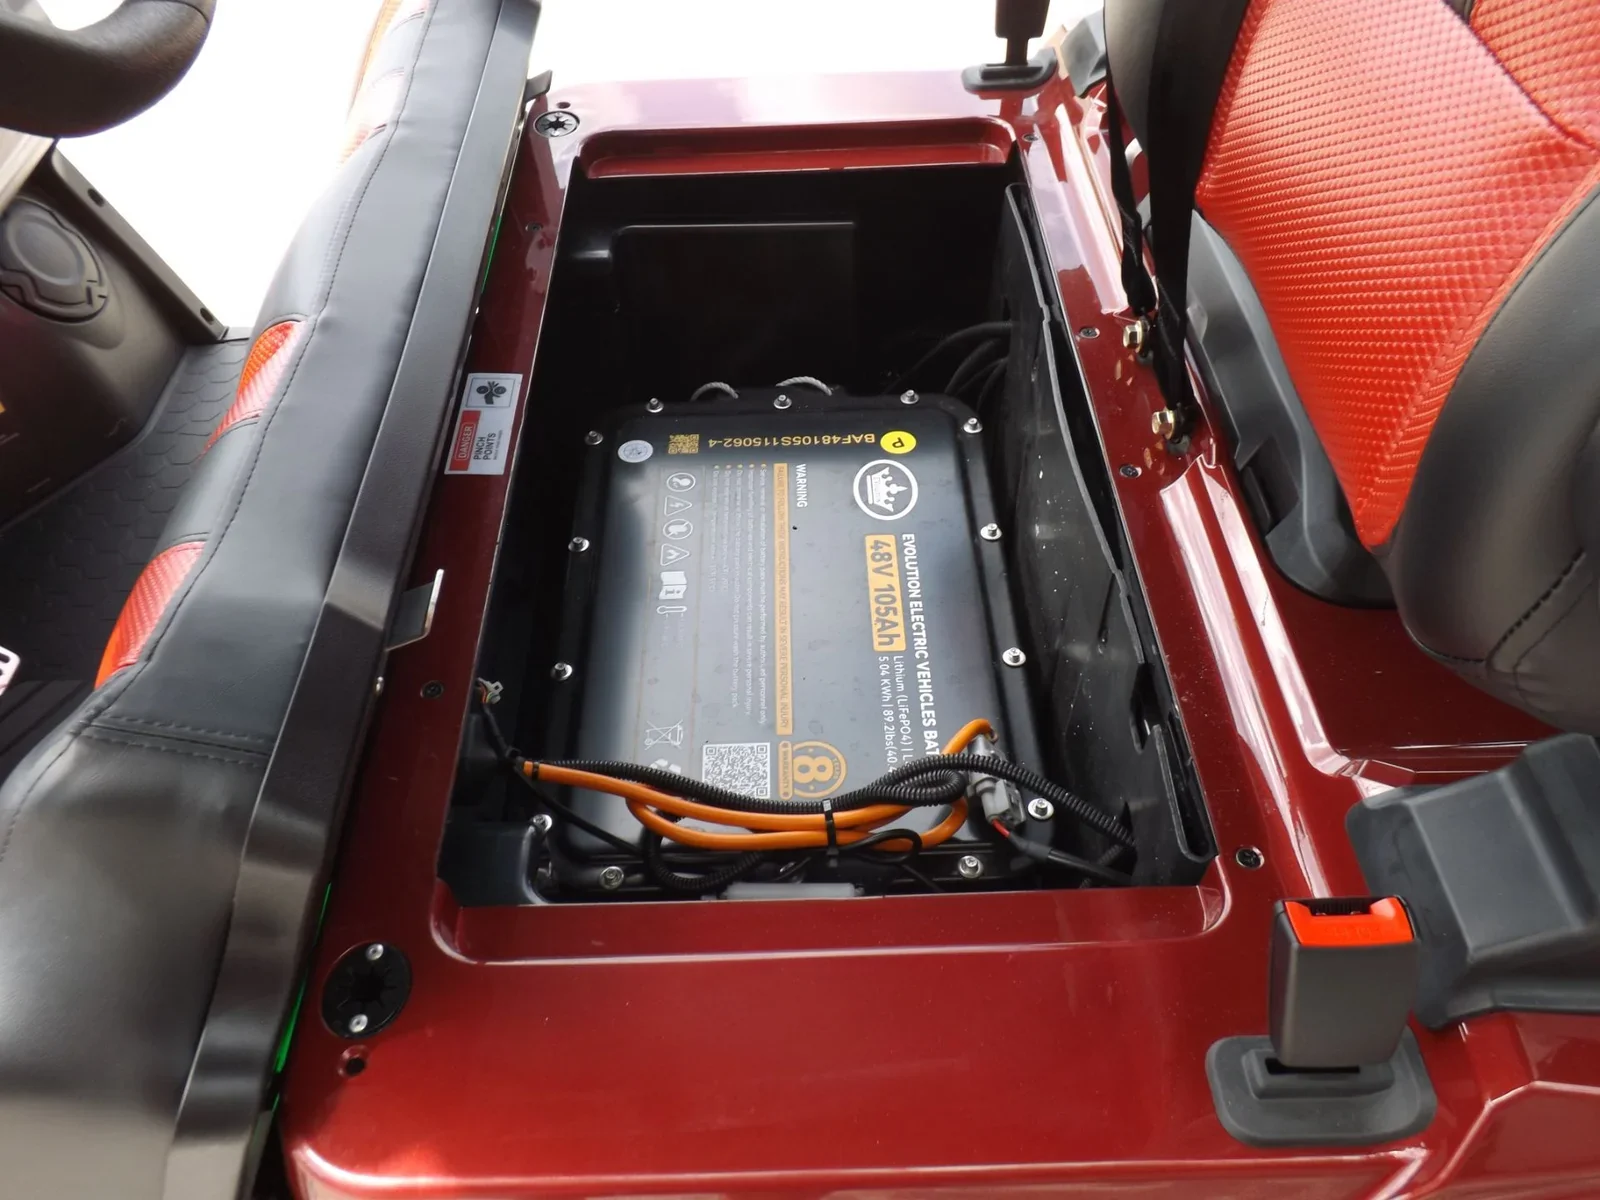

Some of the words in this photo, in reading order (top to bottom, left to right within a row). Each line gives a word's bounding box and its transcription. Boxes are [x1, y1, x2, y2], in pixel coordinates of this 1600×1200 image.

[458, 426, 473, 458] DANGER
[473, 436, 486, 460] PINCH
[482, 432, 497, 460] POINTS
[707, 432, 876, 448] BAF48105S115062-4
[796, 464, 808, 508] WARNING
[870, 540, 894, 577] 48V
[902, 534, 922, 598] EVOLUTION
[874, 584, 900, 646] 105Ah
[909, 601, 928, 659] ELECTRIC
[779, 636, 788, 661] SEVERE
[780, 663, 788, 700] PERSONAL
[878, 656, 889, 676] 5.04
[893, 656, 906, 692] Lithium
[881, 679, 892, 702] KWh
[916, 661, 936, 727] VEHICLES
[780, 703, 789, 728] INJURY
[896, 695, 912, 745] (LiFePO4)
[793, 756, 834, 784] 8
